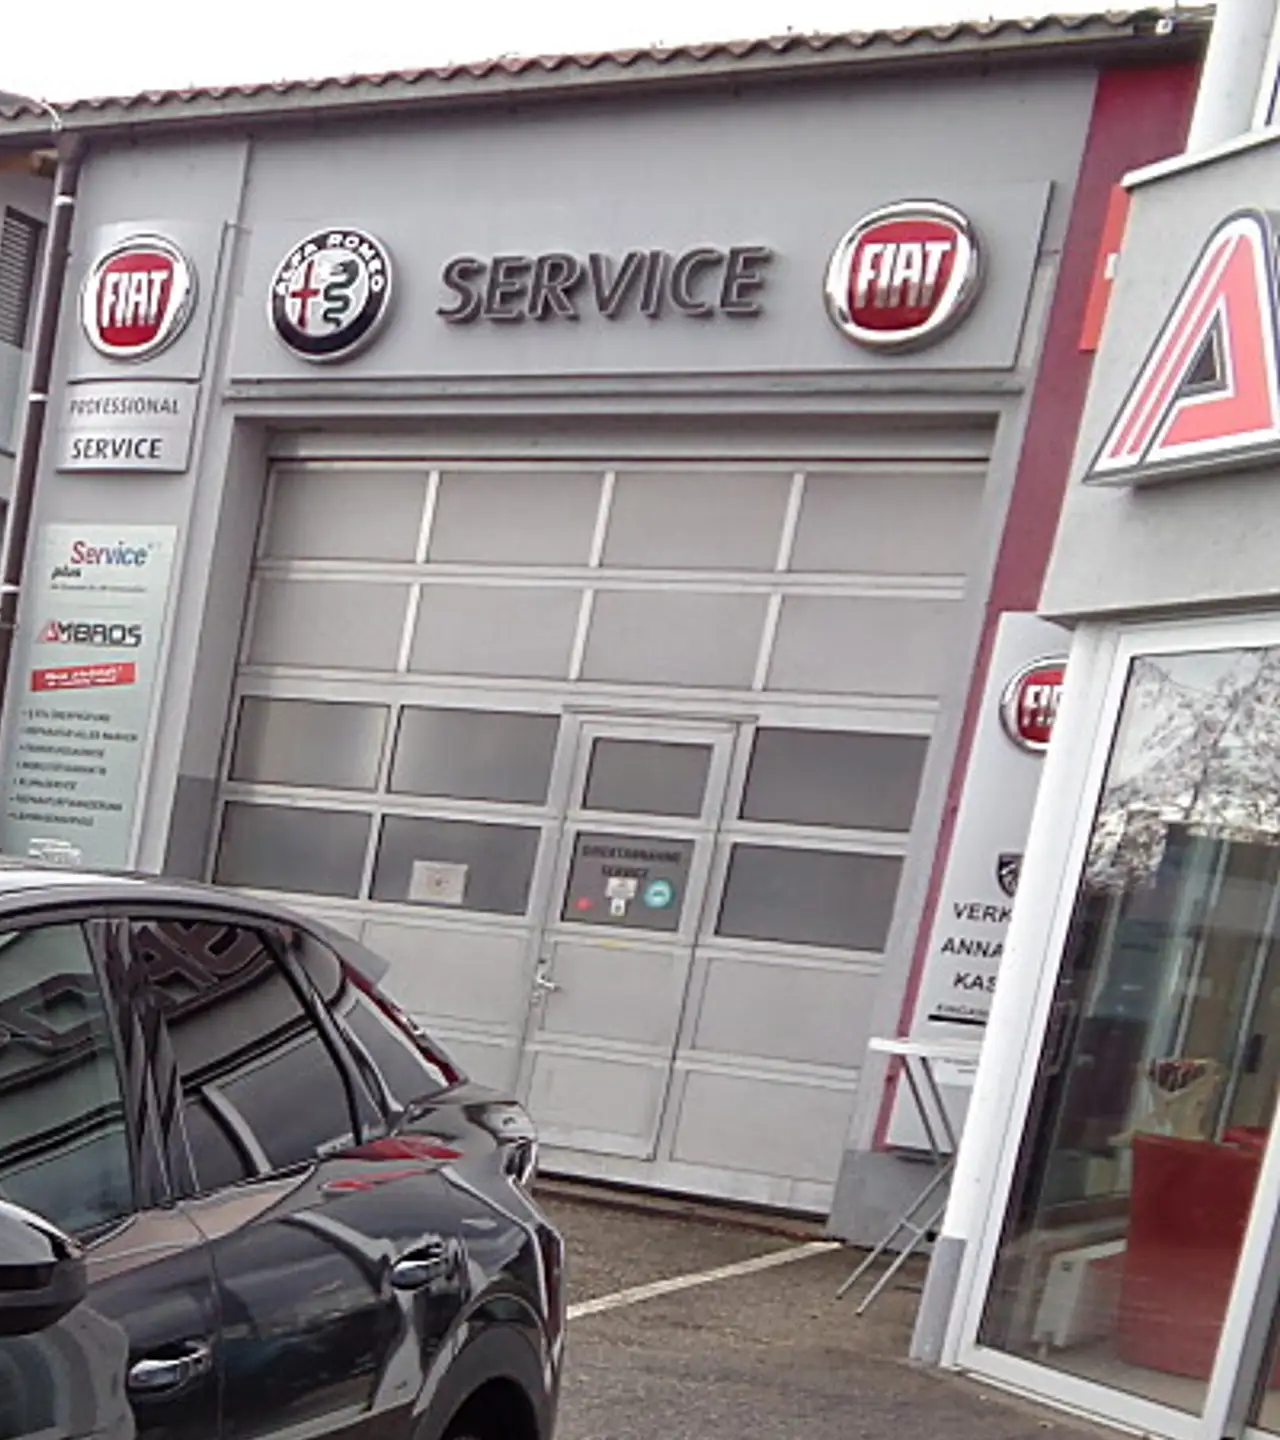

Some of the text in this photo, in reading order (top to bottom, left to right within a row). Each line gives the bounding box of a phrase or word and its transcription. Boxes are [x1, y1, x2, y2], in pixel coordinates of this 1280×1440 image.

[325, 232, 385, 293] ROMEO
[436, 245, 773, 324] SERVICE
[854, 241, 952, 309] FIAT
[101, 271, 169, 328] FIAT
[70, 397, 180, 415] PROFESSIONAL
[71, 437, 164, 460] SERVICE
[70, 540, 148, 566] Service
